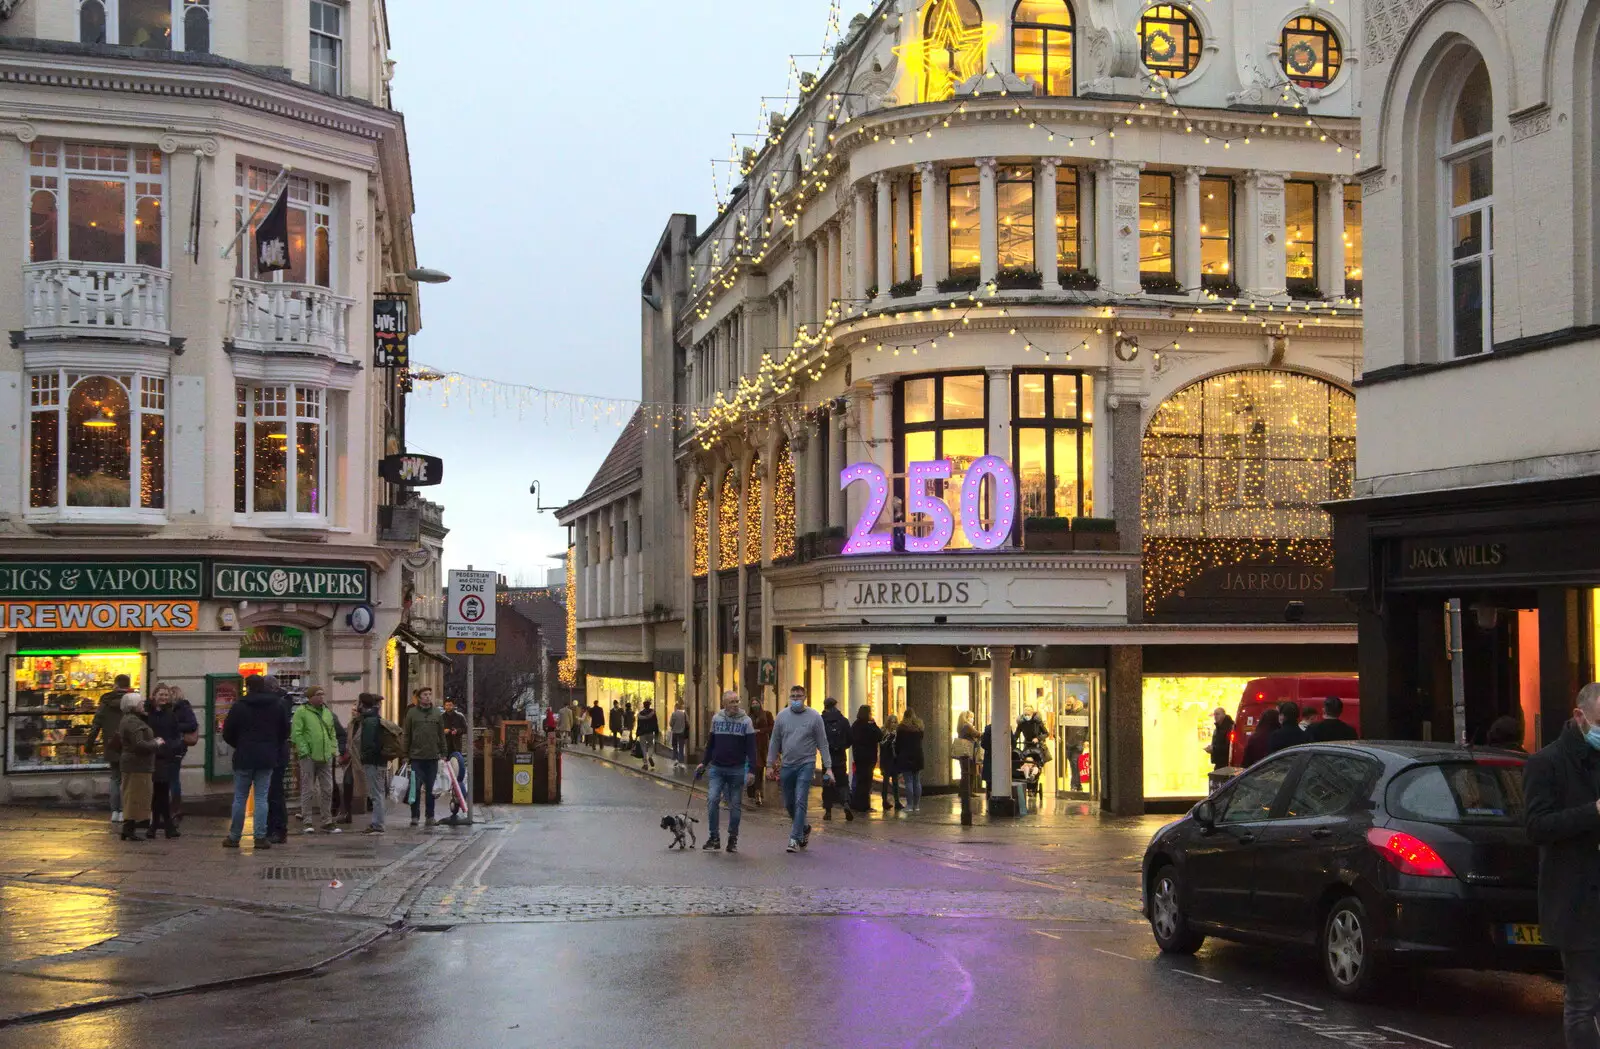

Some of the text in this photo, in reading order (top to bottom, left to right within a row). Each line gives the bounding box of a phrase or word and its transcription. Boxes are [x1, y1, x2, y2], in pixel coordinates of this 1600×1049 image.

[375, 314, 396, 332] JIVE
[398, 456, 428, 481] JIVE
[840, 454, 1016, 555] 250
[1409, 543, 1501, 570] JACK WILLS
[0, 568, 197, 591] CIGS & VAPOURS
[460, 584, 484, 592] ZONE
[1220, 572, 1324, 591] JARROLDS
[853, 581, 969, 605] JARROLDS
[475, 625, 494, 633] loading
